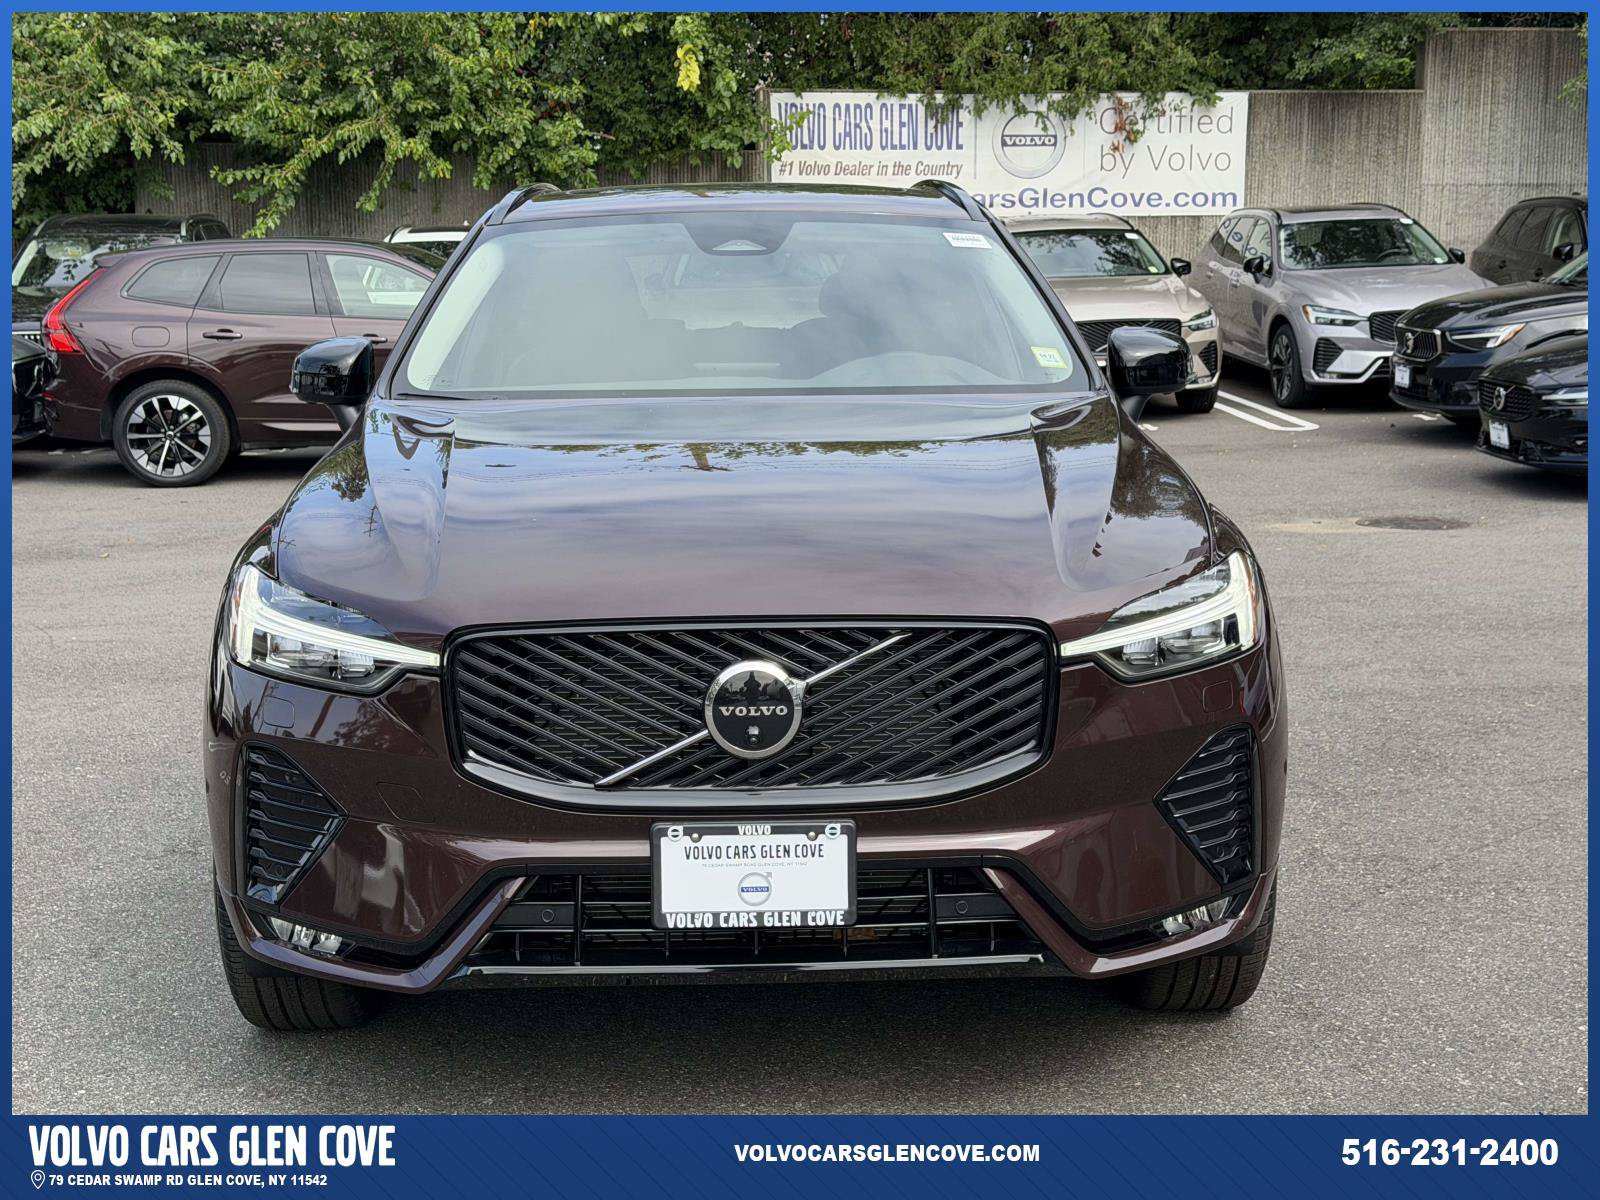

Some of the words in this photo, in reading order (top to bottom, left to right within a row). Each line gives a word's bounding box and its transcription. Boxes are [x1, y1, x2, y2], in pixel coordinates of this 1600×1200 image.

[832, 102, 873, 151] CARS
[879, 102, 918, 151] GLEN
[1099, 106, 1234, 135] Cetified
[1003, 136, 1055, 146] VOLVO
[778, 161, 794, 177] #1
[799, 160, 831, 177] Volvo
[834, 161, 874, 177] Dealer
[876, 161, 888, 177] in
[892, 161, 911, 177] the
[915, 161, 964, 180] Country
[1099, 144, 1135, 179] by
[1147, 144, 1232, 172] Volvo
[719, 705, 788, 717] VOLVO
[738, 825, 772, 836] VOLVO
[684, 845, 722, 860] VOLVO
[726, 844, 757, 860] CARS
[761, 844, 791, 859] GLEN
[794, 843, 825, 858] COVE
[666, 912, 713, 928] VOLVO
[719, 912, 758, 928] CARS
[763, 911, 800, 927] GLEN
[807, 910, 845, 926] COVE
